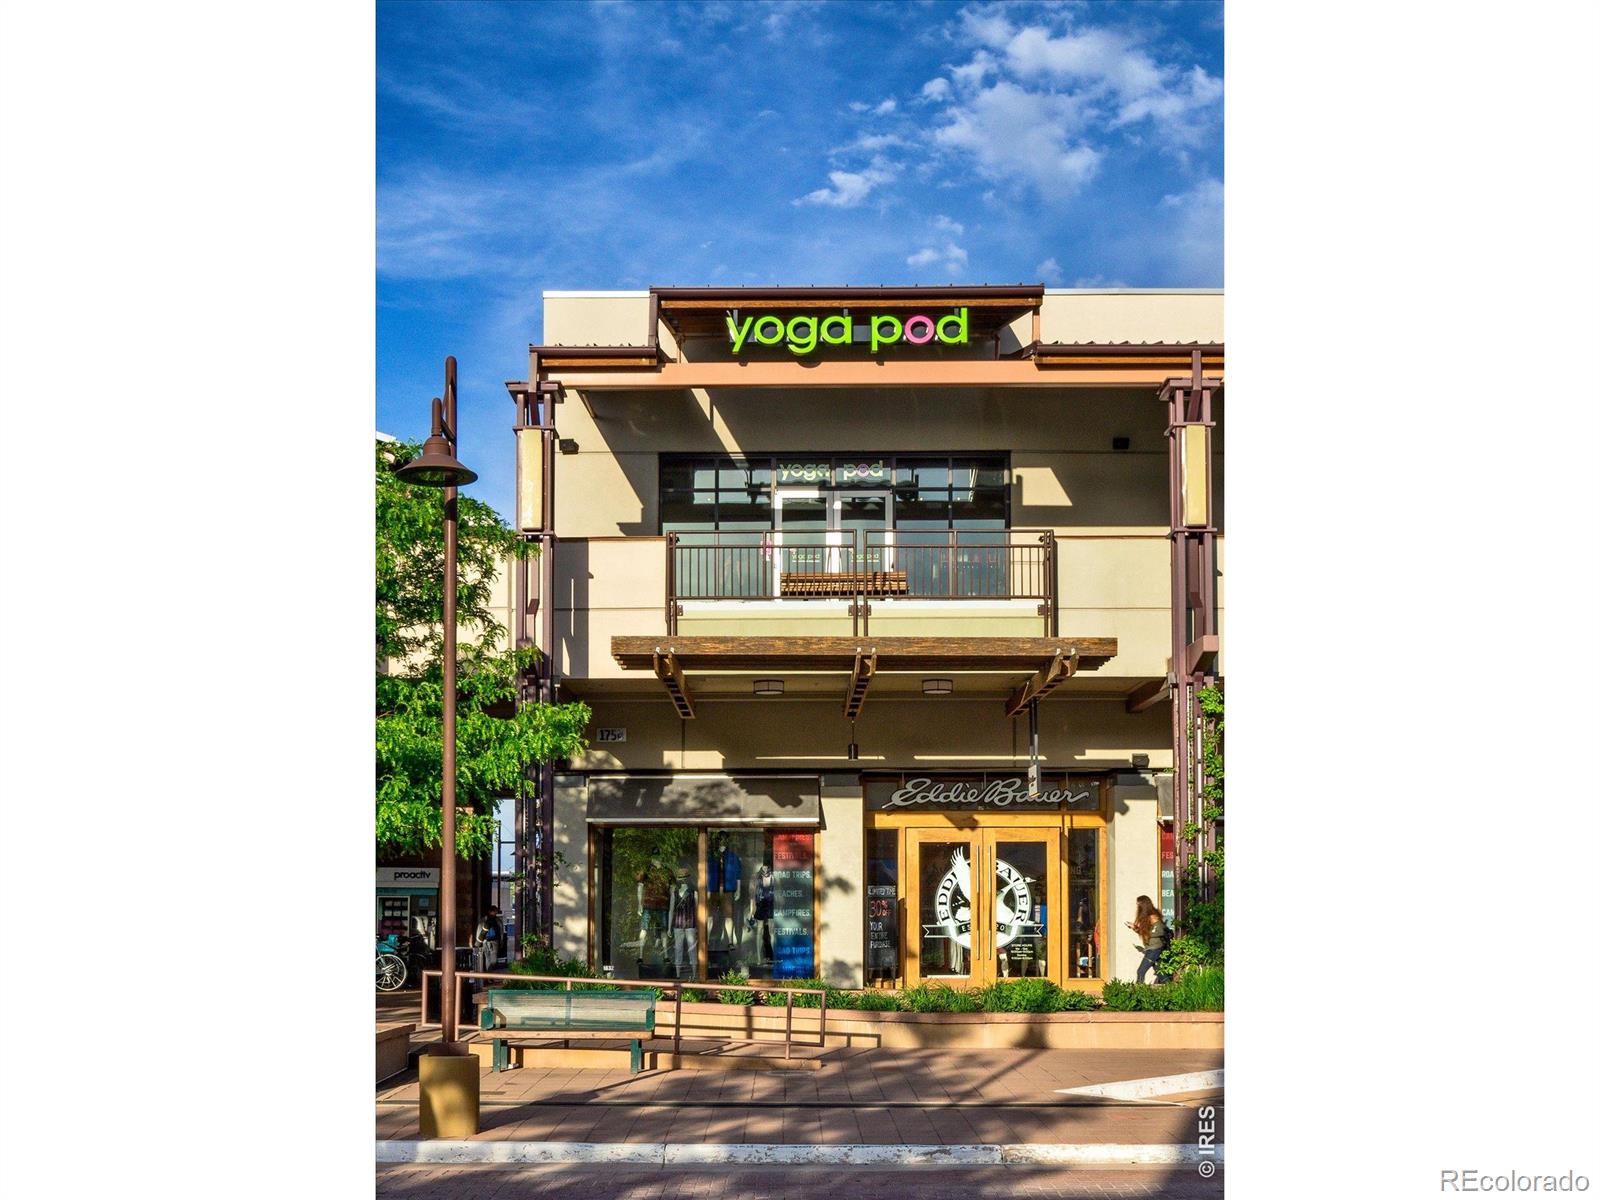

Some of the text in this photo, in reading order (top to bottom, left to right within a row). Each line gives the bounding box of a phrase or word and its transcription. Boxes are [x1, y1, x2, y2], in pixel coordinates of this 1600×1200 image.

[726, 307, 968, 353] yoga pod
[780, 460, 883, 480] yoga pod
[881, 778, 1089, 809] Eddie Bauer
[1162, 851, 1174, 860] FES
[393, 871, 431, 881] proactiv
[1162, 870, 1174, 879] ROA
[996, 862, 1028, 922] AUER
[1162, 889, 1174, 897] BEA
